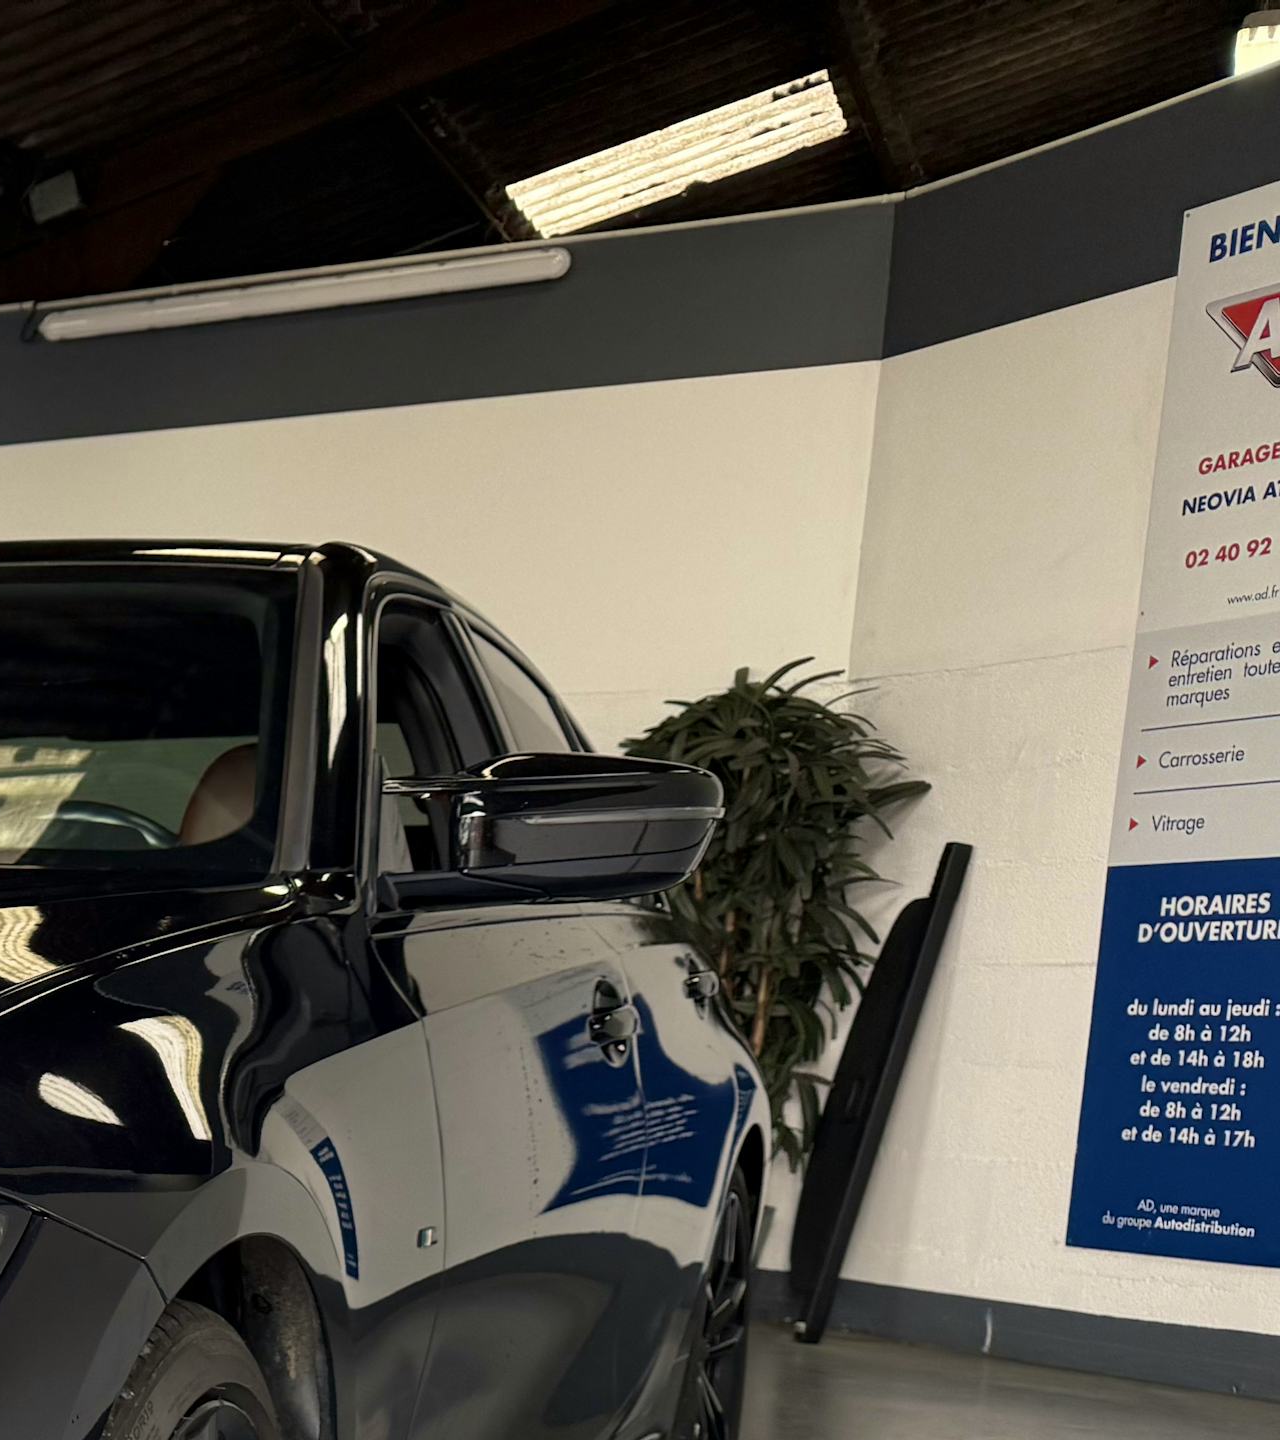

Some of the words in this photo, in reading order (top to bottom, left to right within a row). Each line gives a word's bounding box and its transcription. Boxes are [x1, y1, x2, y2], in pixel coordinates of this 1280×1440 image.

[1198, 442, 1280, 475] GARAGE
[1182, 485, 1256, 516] NEOVIA
[1185, 549, 1209, 568] 02
[1215, 543, 1240, 562] 40
[1247, 537, 1272, 557] 92
[1227, 584, 1279, 604] www.ad.fr
[1171, 642, 1261, 671] Réparations
[1168, 665, 1232, 687] entretien
[1166, 688, 1230, 708] marques
[1159, 745, 1245, 768] Carrosserie
[1152, 815, 1205, 835] Vitrage
[1160, 892, 1271, 917] HORAIRES
[1137, 919, 1280, 943] D'OUVERTUR
[1126, 998, 1148, 1016] du
[1152, 998, 1194, 1016] lundi
[1199, 1004, 1221, 1017] au
[1226, 998, 1271, 1021] jeudi
[1148, 1023, 1169, 1041] de
[1174, 1024, 1195, 1041] 8h
[1200, 1024, 1212, 1042] à
[1220, 1024, 1251, 1042] 12h
[1130, 1051, 1146, 1065] et
[1150, 1048, 1171, 1066] de
[1178, 1049, 1208, 1067] 14h
[1213, 1050, 1225, 1067] à
[1233, 1050, 1265, 1068] 18h
[1141, 1075, 1156, 1093] le
[1161, 1076, 1235, 1095] vendredi
[1139, 1100, 1160, 1118] de
[1165, 1101, 1186, 1119] 8h
[1191, 1102, 1202, 1119] à
[1210, 1103, 1241, 1121] 12h
[1121, 1127, 1138, 1141] et
[1142, 1124, 1162, 1143] de
[1169, 1127, 1199, 1145] 14h
[1204, 1128, 1215, 1146] à
[1224, 1130, 1255, 1148] 17h
[1137, 1199, 1157, 1214] AD,
[1160, 1203, 1178, 1215] une
[1181, 1206, 1220, 1219] marque
[1102, 1211, 1115, 1225] du
[1117, 1217, 1152, 1230] groupe
[1154, 1216, 1255, 1237] Autodistribution
